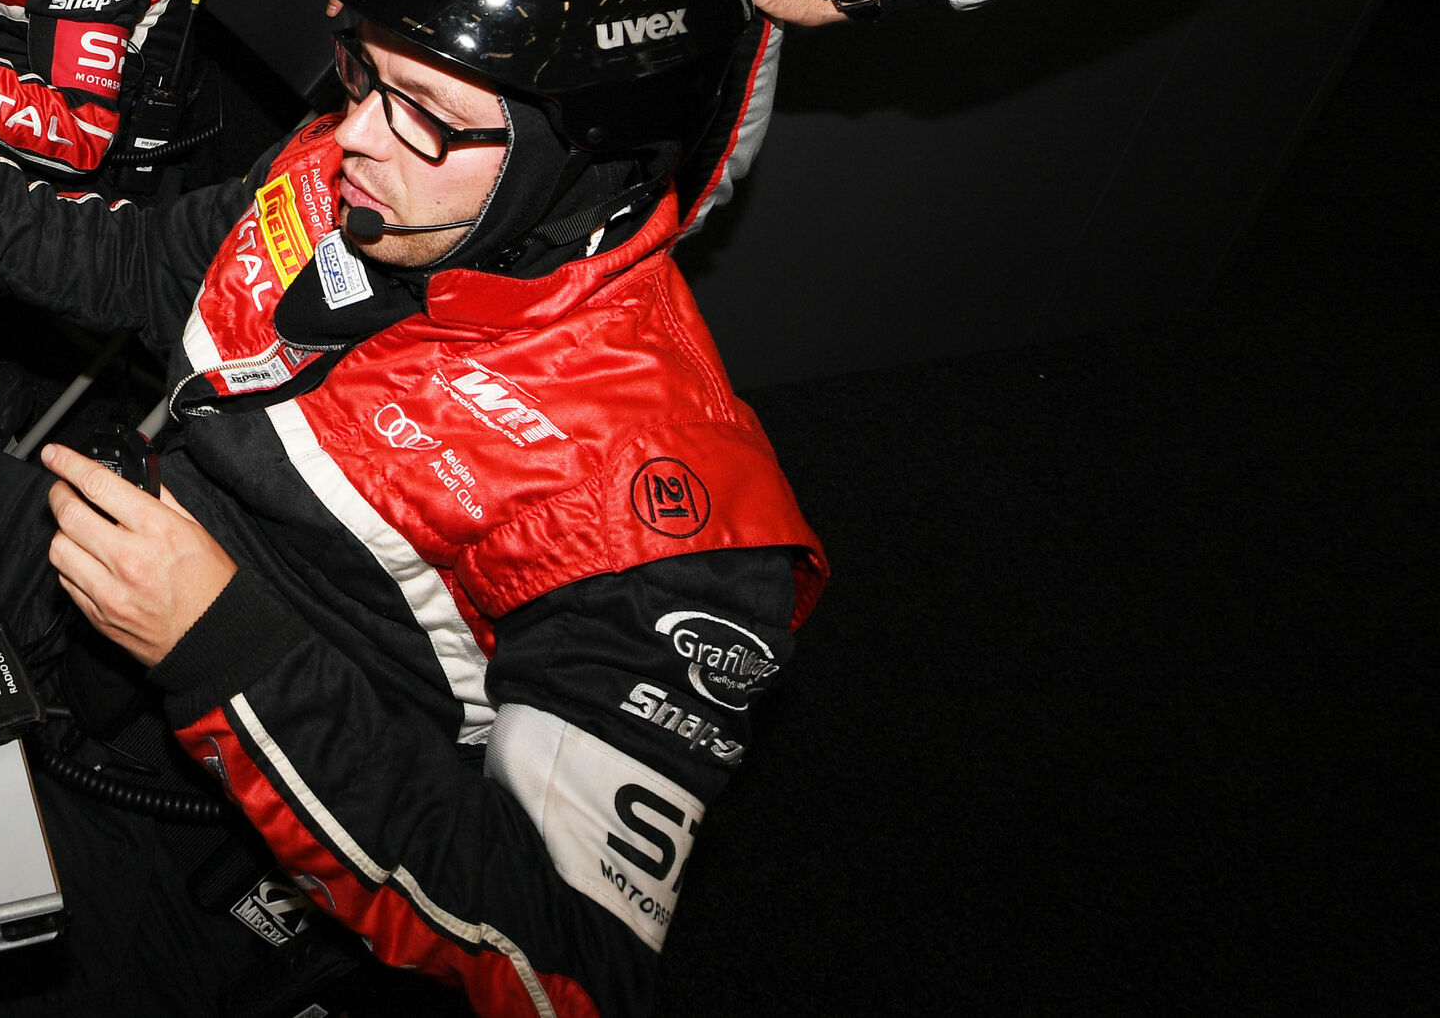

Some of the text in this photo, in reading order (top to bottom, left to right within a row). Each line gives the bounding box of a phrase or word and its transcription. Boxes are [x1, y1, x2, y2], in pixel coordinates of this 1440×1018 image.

[595, 8, 689, 50] uvex
[311, 167, 326, 193] Audi
[324, 243, 348, 295] sparco
[451, 370, 569, 444] WRT
[441, 447, 476, 488] Belgian
[428, 460, 484, 520] Audi Club
[654, 476, 689, 519] 21
[1, 664, 18, 694] RADIO
